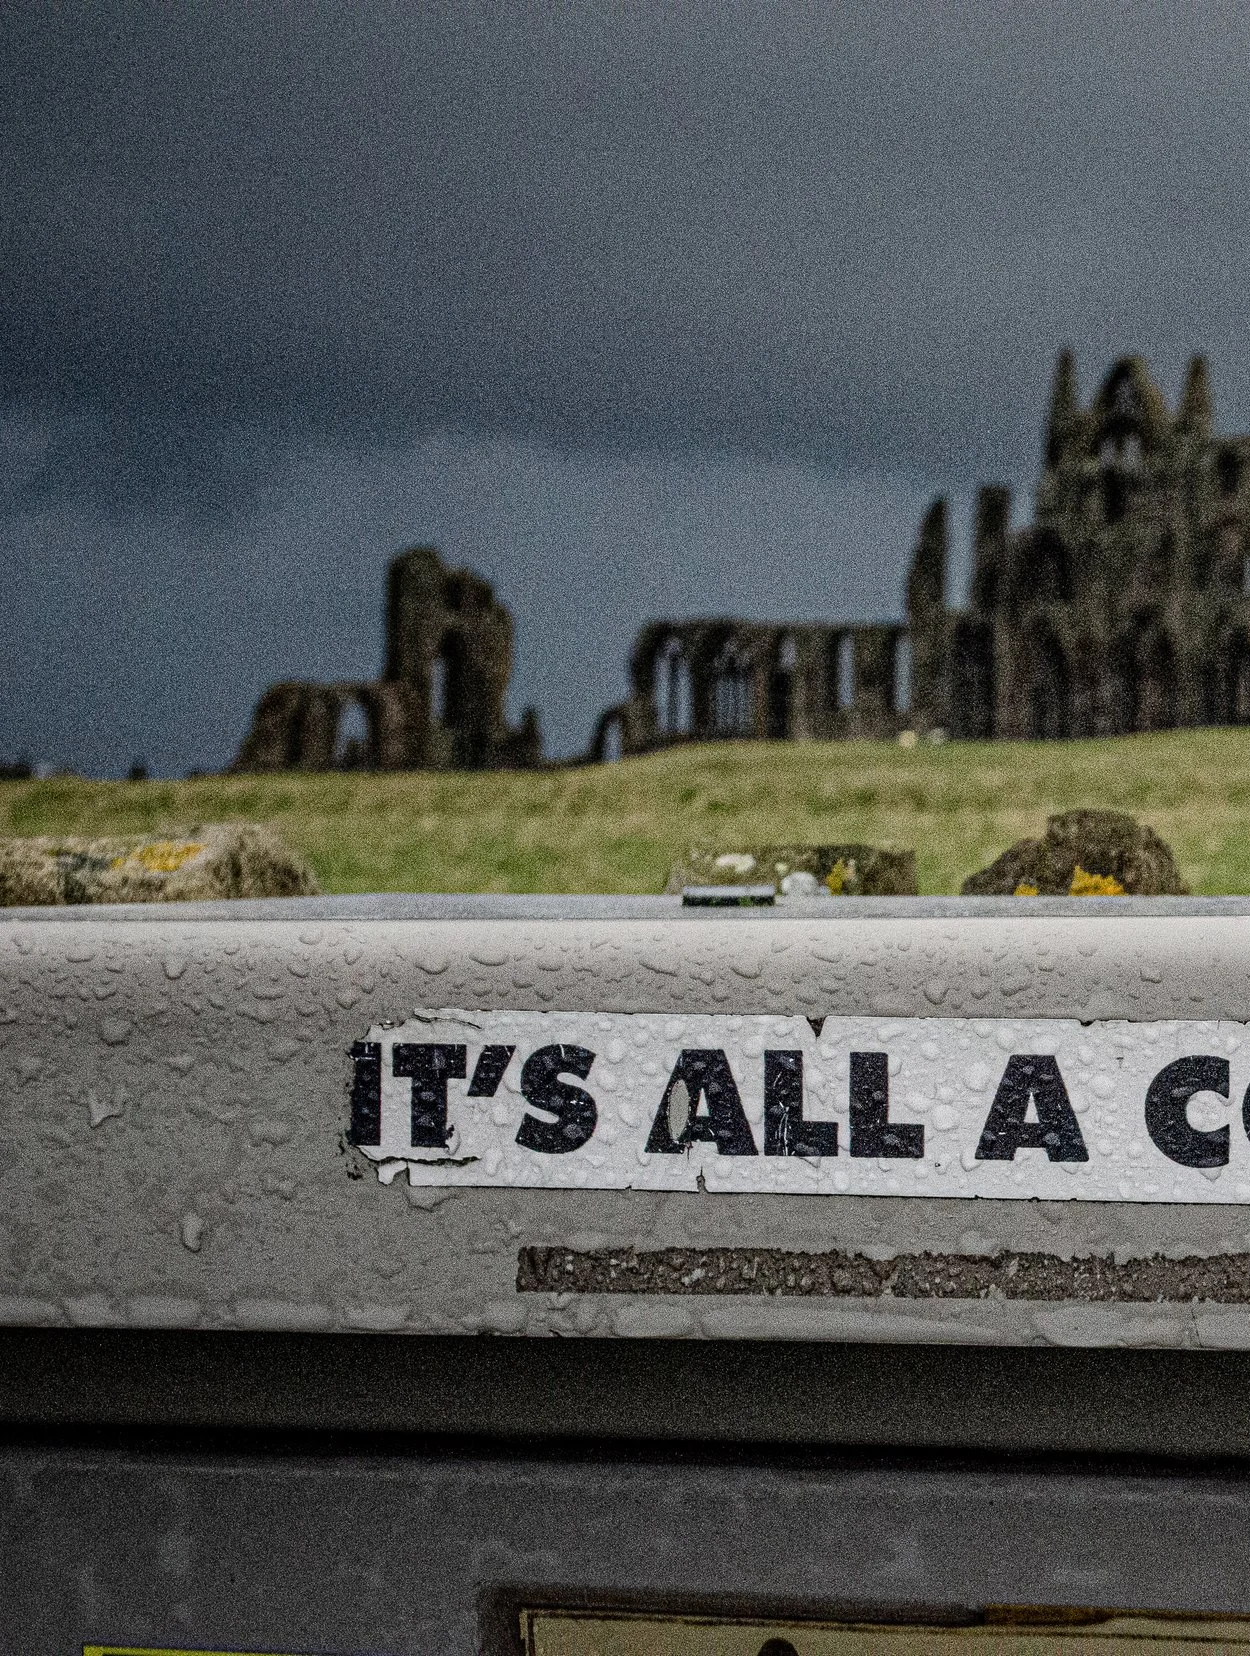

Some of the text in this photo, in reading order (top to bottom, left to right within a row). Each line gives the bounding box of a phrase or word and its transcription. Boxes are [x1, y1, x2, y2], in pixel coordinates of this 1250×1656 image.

[347, 1041, 598, 1154] IT'S
[645, 1049, 925, 1159] ALL
[974, 1054, 1090, 1163] A
